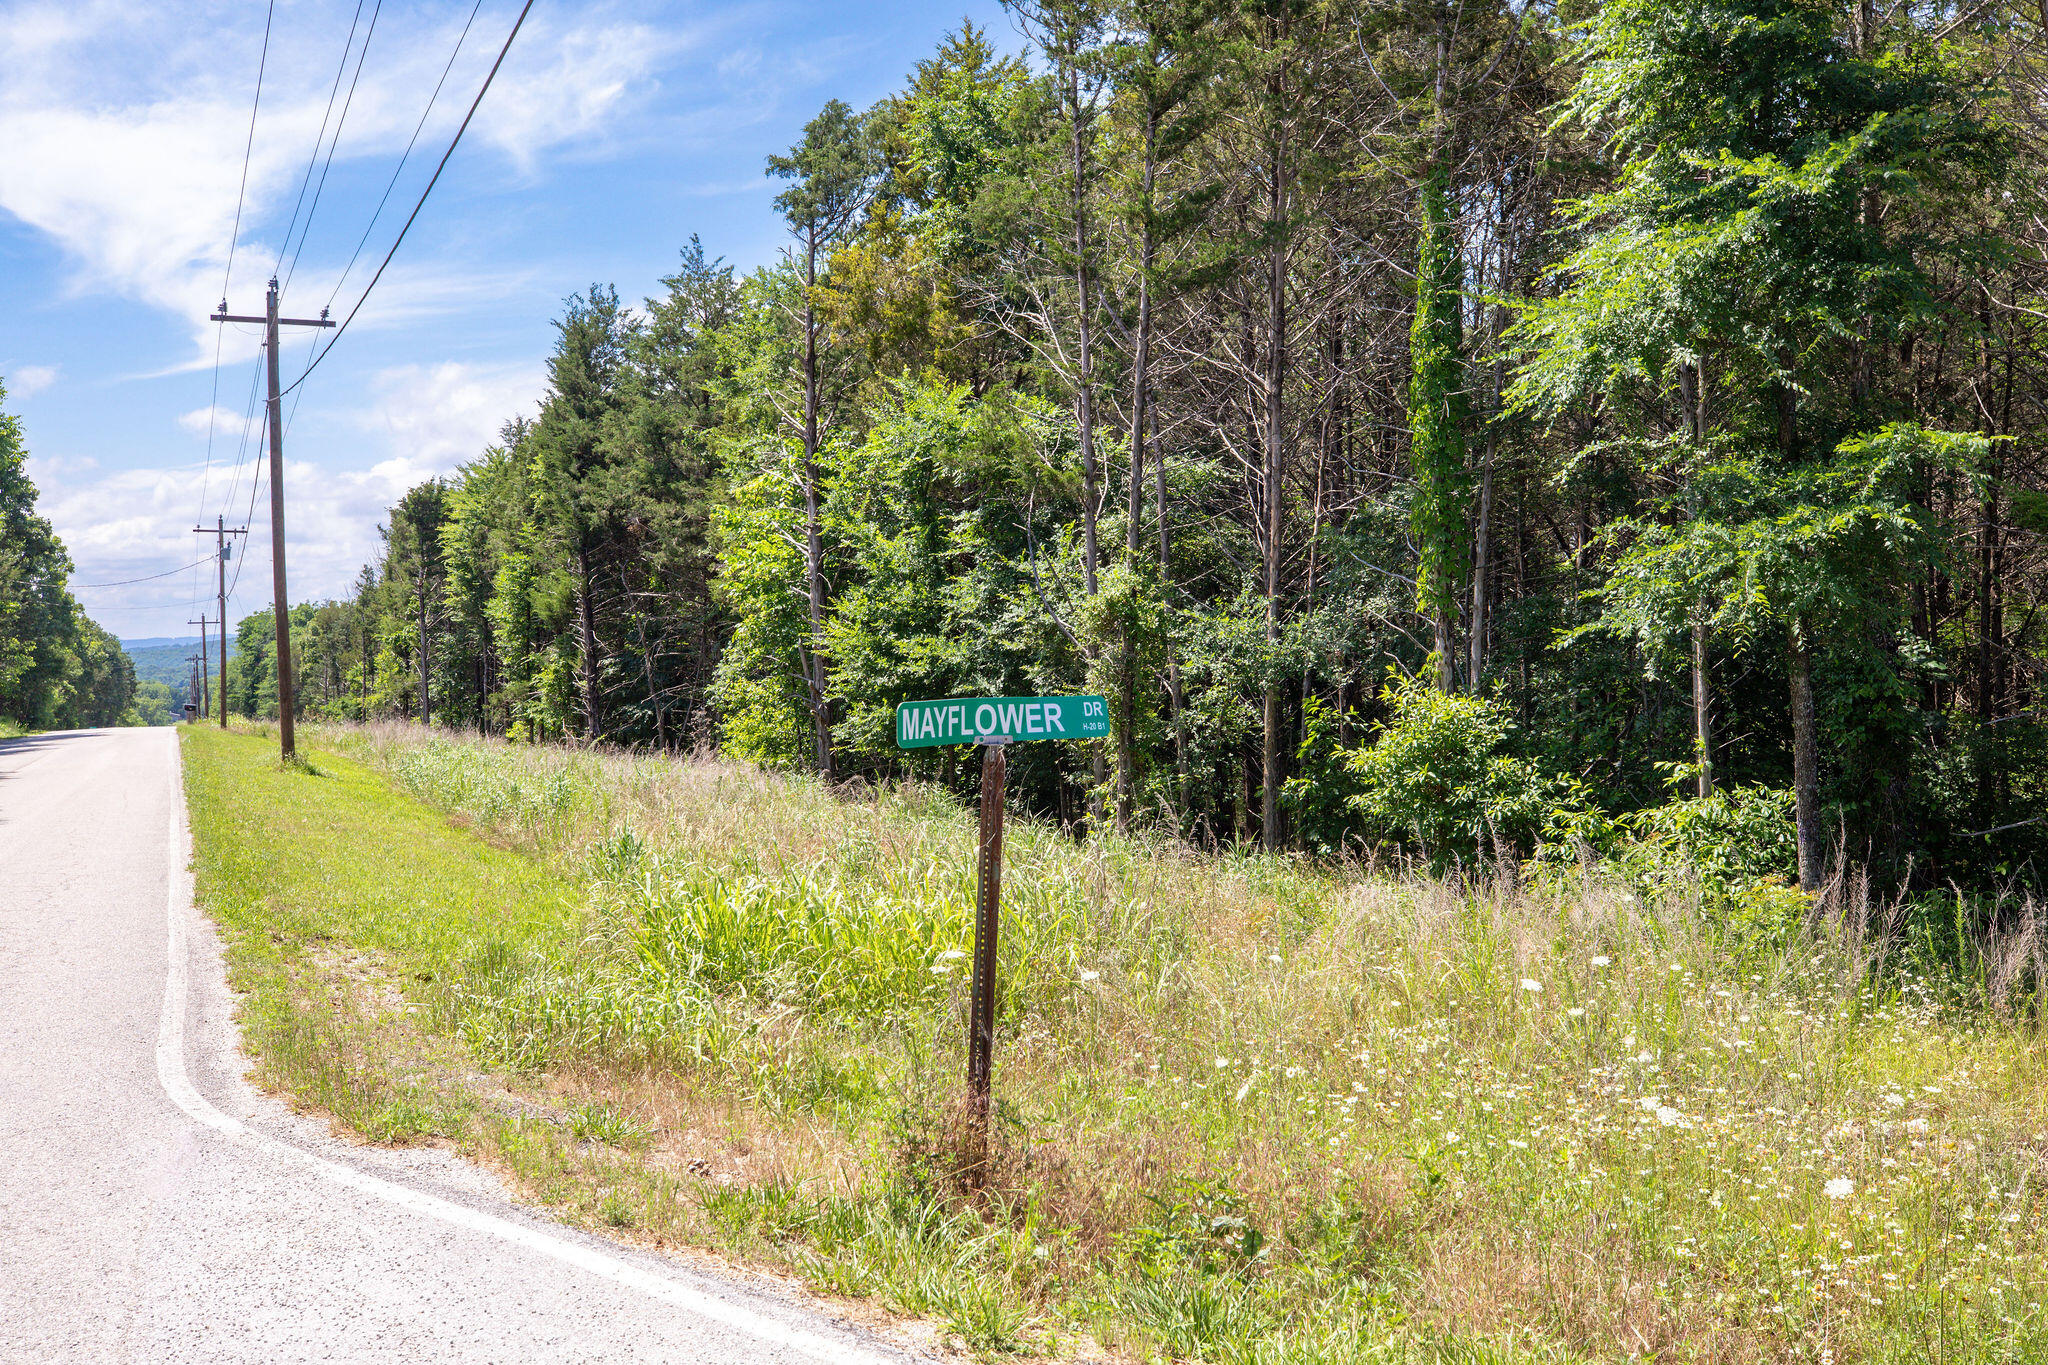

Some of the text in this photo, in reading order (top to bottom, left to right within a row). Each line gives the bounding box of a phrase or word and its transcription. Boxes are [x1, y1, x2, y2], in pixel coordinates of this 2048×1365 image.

[902, 701, 1103, 740] MAYFLOWER DR
[1083, 722, 1106, 730] H-20 B1
